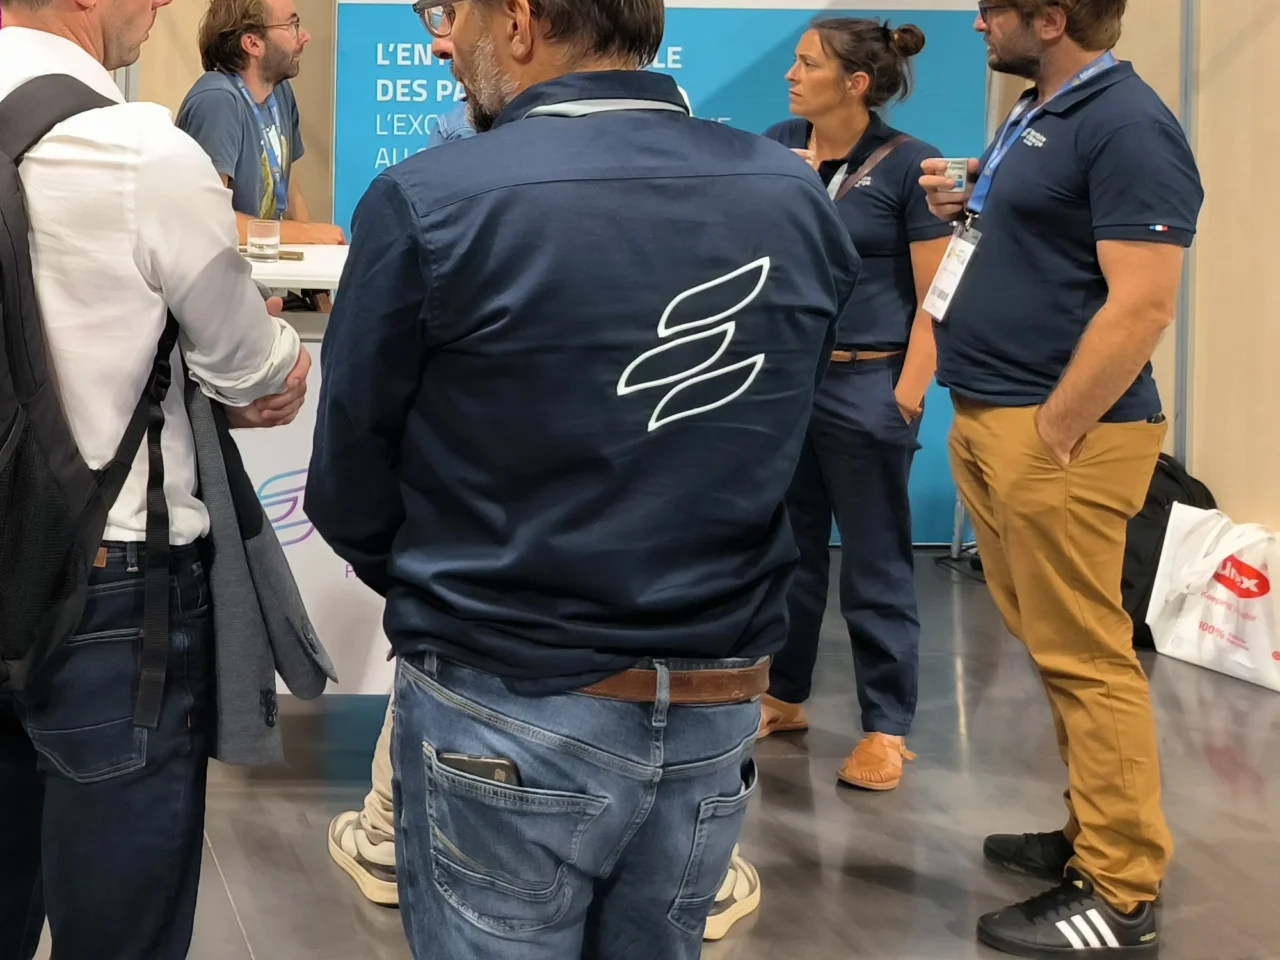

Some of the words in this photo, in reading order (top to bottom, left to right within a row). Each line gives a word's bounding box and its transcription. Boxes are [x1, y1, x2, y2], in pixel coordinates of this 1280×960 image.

[376, 42, 434, 66] L'EN
[376, 79, 428, 102] DES
[436, 79, 468, 102] PA
[1198, 620, 1225, 640] 100%
